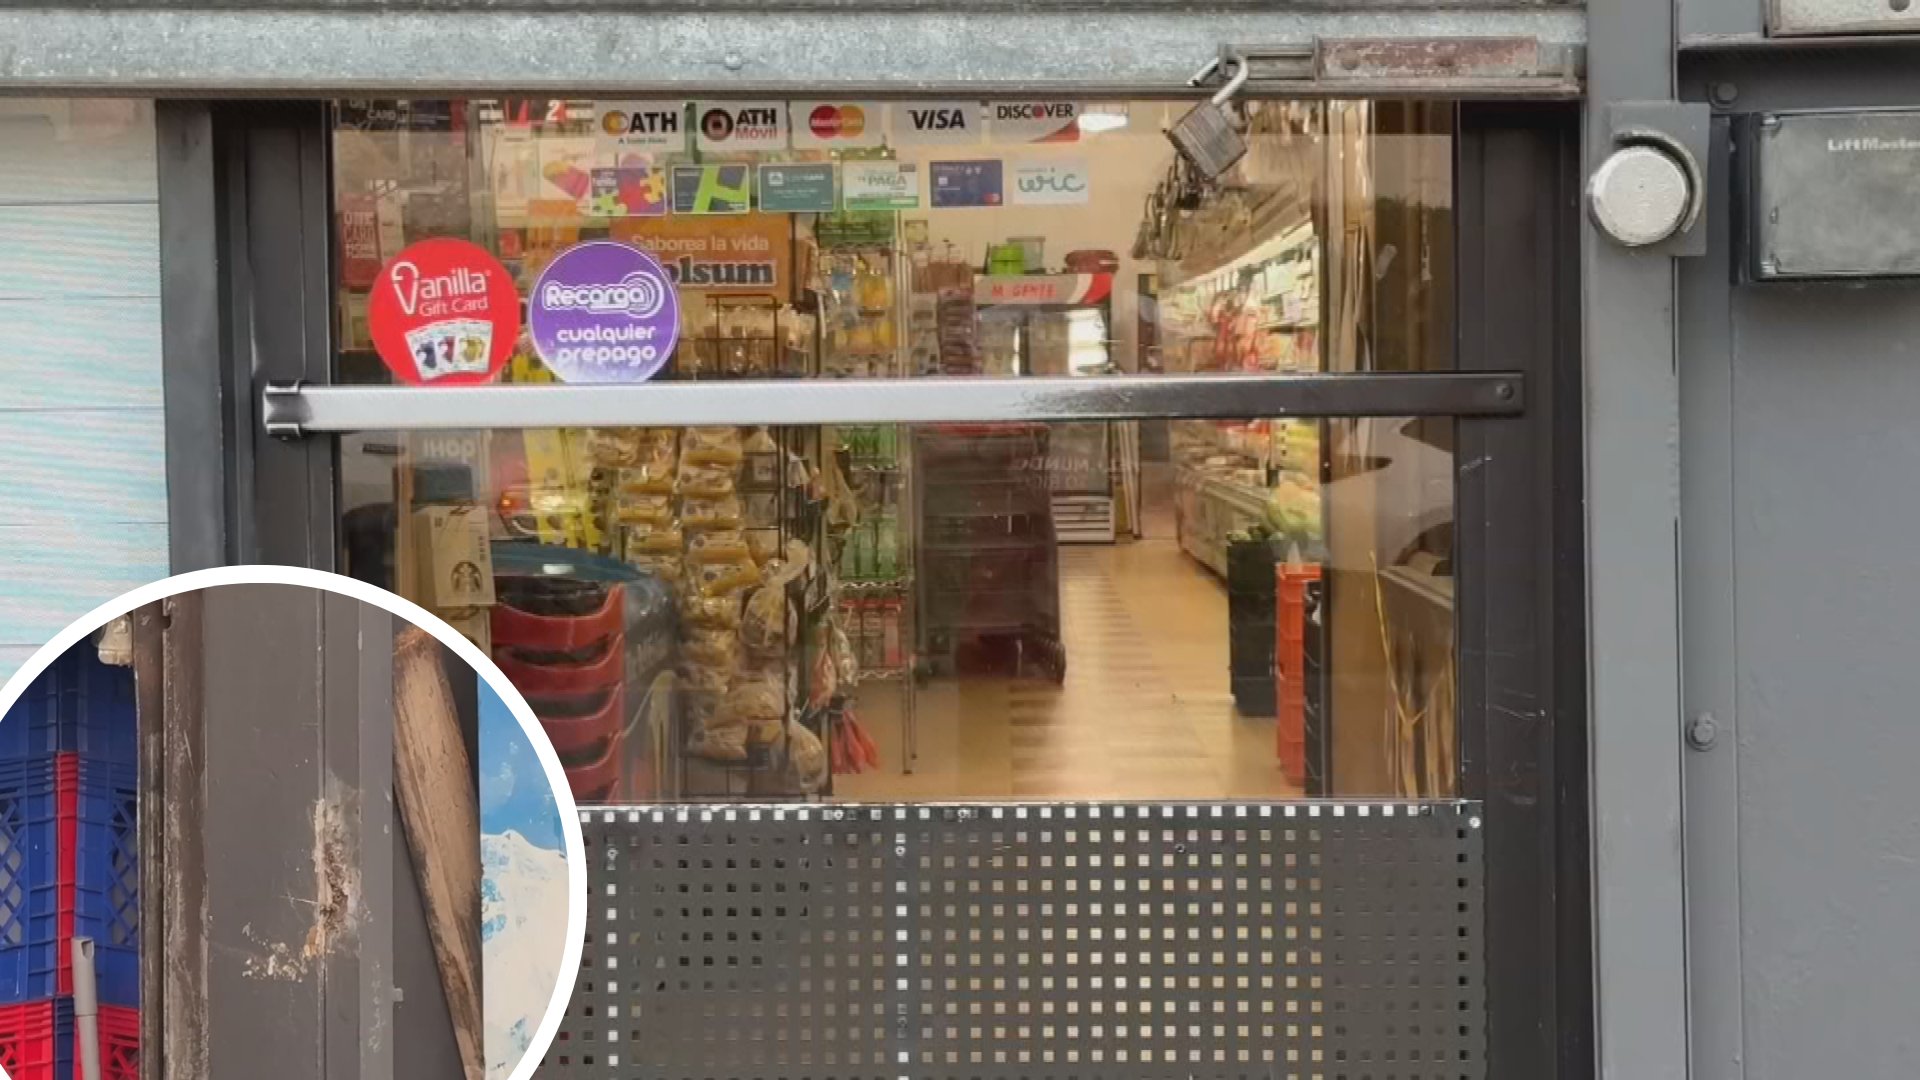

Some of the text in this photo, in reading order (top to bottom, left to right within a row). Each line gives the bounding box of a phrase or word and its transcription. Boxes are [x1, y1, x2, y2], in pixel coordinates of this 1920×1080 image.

[736, 108, 778, 125] ATH
[907, 109, 966, 130] VISA
[997, 103, 1074, 120] DISCOVER
[628, 111, 678, 134] ATH
[631, 233, 769, 251] Saborea la vida
[661, 255, 778, 286] olsum
[390, 261, 488, 315] Vanilla
[544, 283, 646, 312] Recarga
[419, 296, 489, 317] Gift Card
[556, 324, 657, 345] cualquier
[556, 346, 657, 367] prepago
